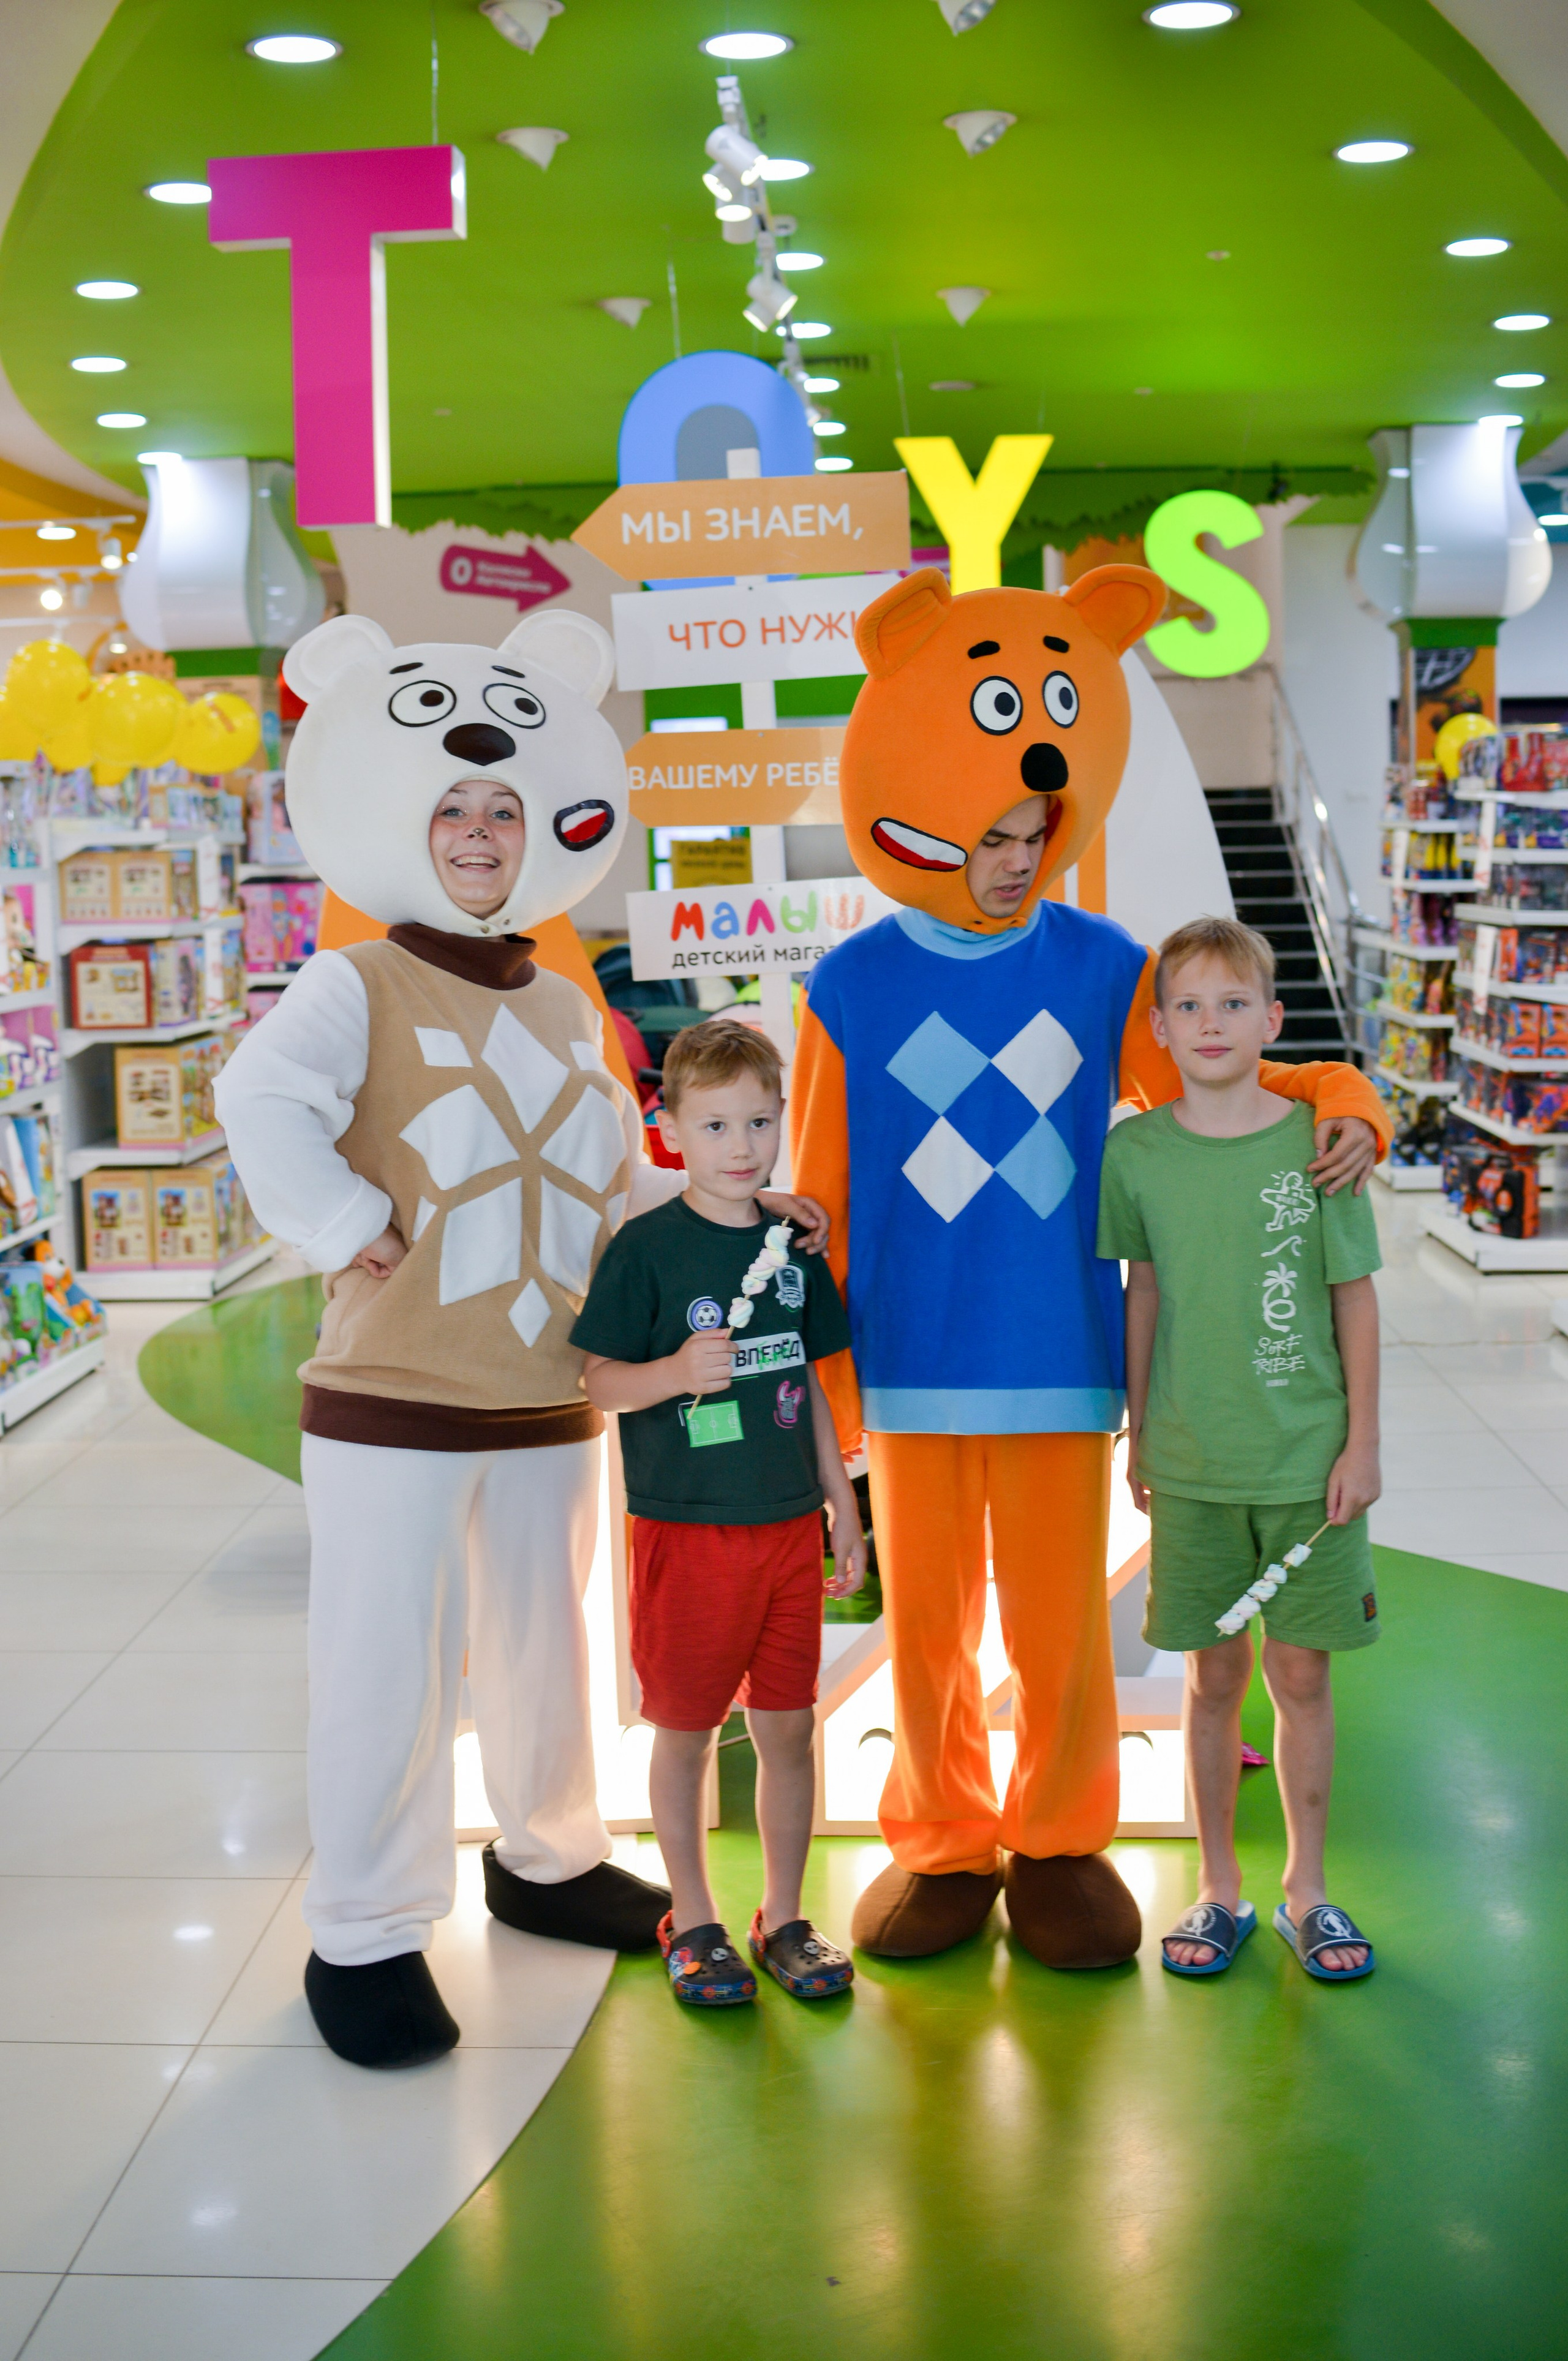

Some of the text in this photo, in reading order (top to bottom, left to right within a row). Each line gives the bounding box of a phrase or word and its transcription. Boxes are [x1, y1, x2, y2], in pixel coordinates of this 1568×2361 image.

[622, 503, 864, 545] МЫ ЗНАЕМ,
[668, 619, 747, 651] ЧТО
[628, 763, 759, 791] ВАШЕМУ
[672, 944, 837, 969] детский мага
[1251, 1355, 1306, 1375] TRIBE
